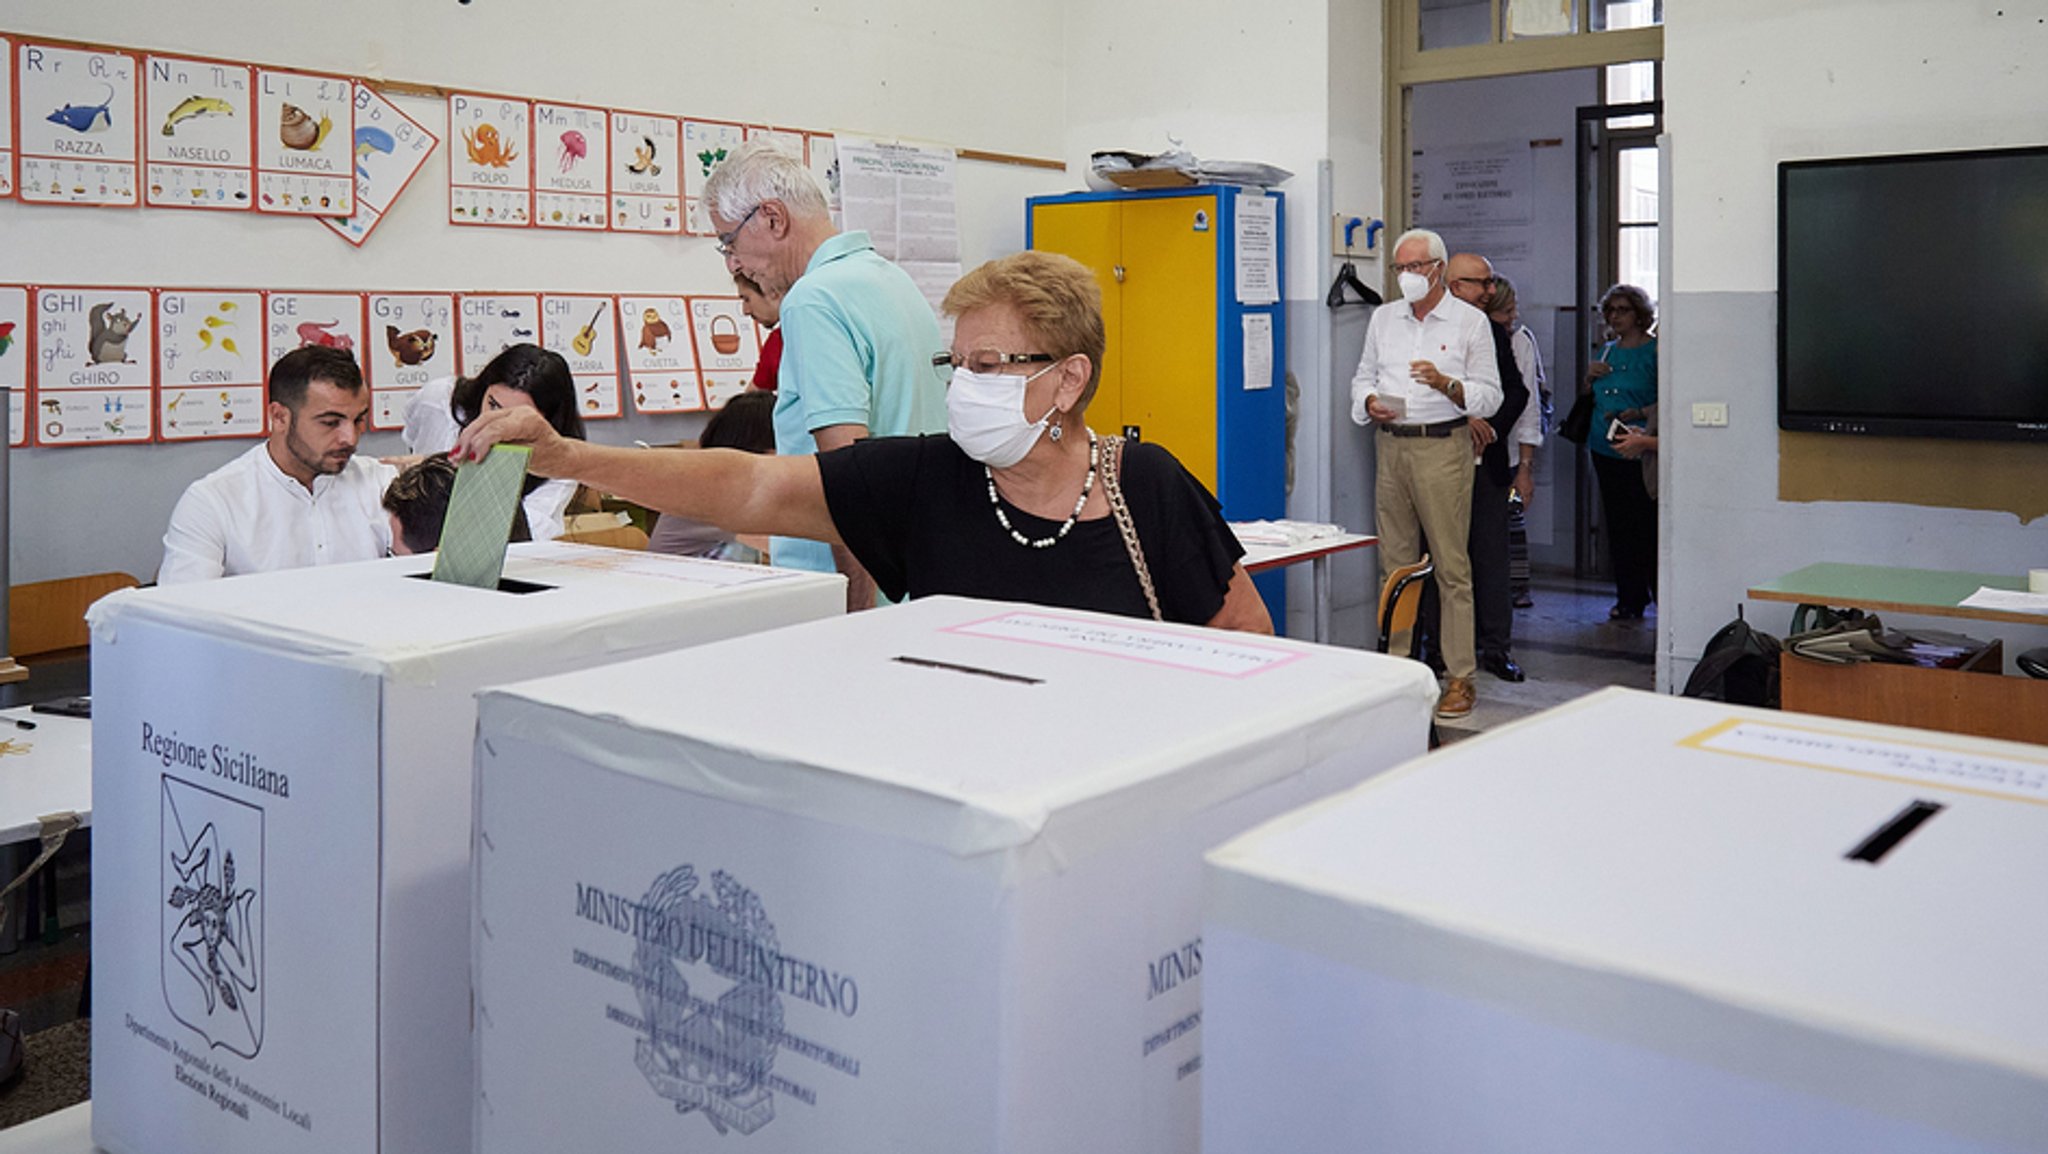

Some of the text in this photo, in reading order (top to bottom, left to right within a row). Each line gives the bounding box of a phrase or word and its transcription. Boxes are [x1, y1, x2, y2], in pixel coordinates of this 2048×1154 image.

[27, 50, 44, 71] R
[53, 61, 63, 74] r
[153, 61, 170, 83] N
[177, 70, 189, 85] n
[263, 75, 276, 96] L
[355, 89, 371, 110] B
[455, 98, 468, 116] P
[538, 107, 554, 124] M
[616, 115, 628, 133] U
[685, 123, 695, 140] E
[54, 139, 105, 156] RAZZA
[167, 146, 231, 162] NASELLO
[279, 155, 333, 171] LUMACA
[472, 171, 510, 185] POLPO
[551, 178, 592, 190] MEDUSA
[629, 181, 661, 193] UPUPA
[640, 203, 651, 220] U
[41, 294, 83, 314] GHI
[163, 297, 185, 315] GI
[271, 297, 298, 315] GE
[374, 297, 390, 318] G
[463, 300, 495, 316] CHE
[545, 300, 570, 316] CHI
[694, 303, 710, 318] CE
[41, 319, 67, 336] ghi
[163, 322, 178, 337] gi
[271, 323, 289, 337] ge
[464, 321, 483, 333] che
[41, 338, 76, 371] ghi
[715, 358, 743, 368] CESTO
[642, 358, 680, 369] CIVETTA
[69, 371, 121, 386] GHIRO
[189, 370, 233, 384] GIRINI
[395, 370, 429, 385] GUFO
[141, 721, 290, 799] Regione Siciliana
[575, 881, 684, 953] MINISTERO
[689, 921, 859, 1019] DELL'INTERNO
[125, 1012, 312, 1132] Dipartimento Regionale delle Autonomie Locali
[175, 1064, 249, 1121] Elezioni Regionali
